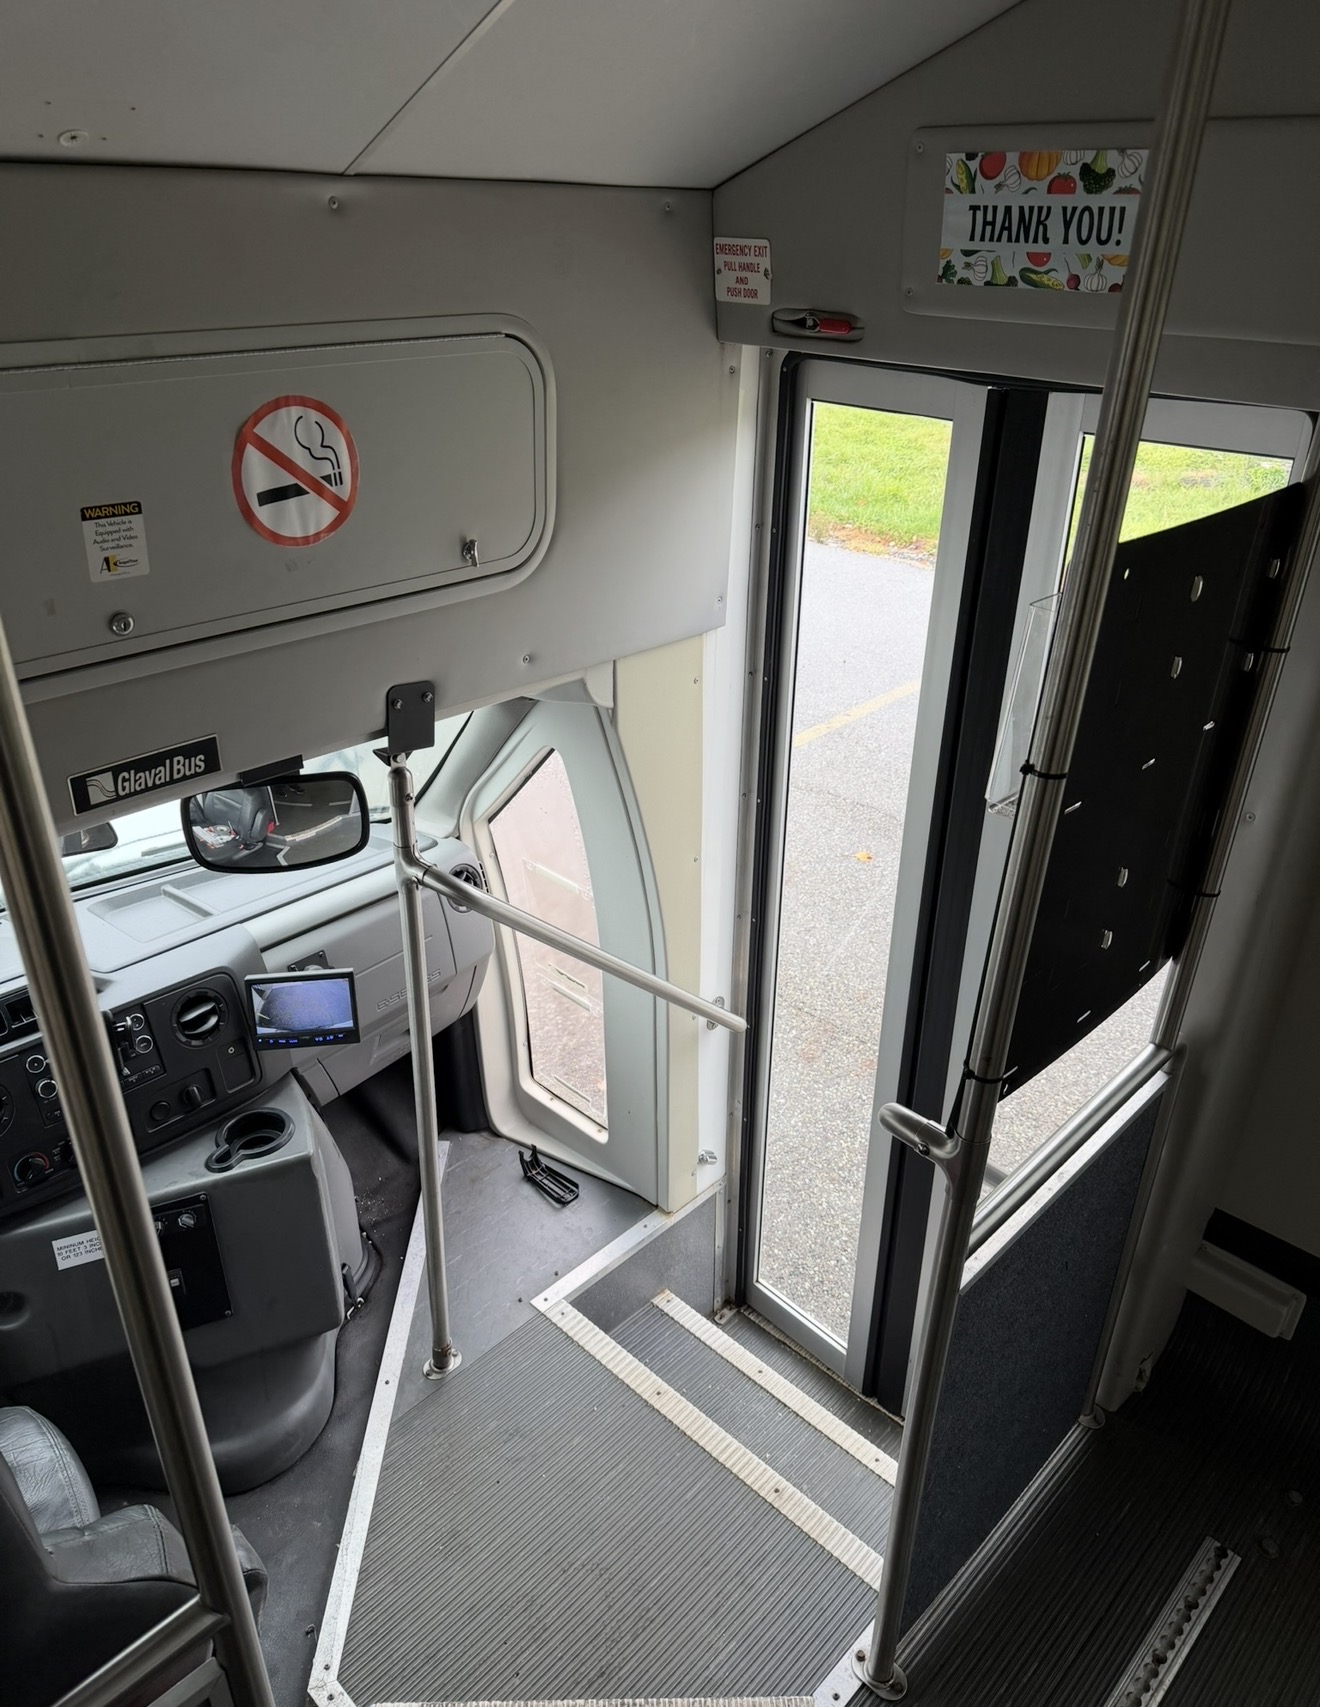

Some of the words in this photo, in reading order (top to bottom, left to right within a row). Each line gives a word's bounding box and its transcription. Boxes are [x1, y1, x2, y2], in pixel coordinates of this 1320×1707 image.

[968, 205, 1052, 245] THANK
[1061, 205, 1127, 247] YOU!
[715, 243, 752, 257] EMERGENCY
[753, 245, 768, 258] EXIT
[723, 260, 737, 272] PULL
[738, 261, 761, 274] HANDLE
[735, 276, 749, 286] AND
[726, 286, 742, 298] PUSH
[742, 287, 759, 300] DOOR
[83, 503, 139, 519] WARNING
[106, 519, 127, 527] Vehicle
[94, 527, 121, 538] Equipped
[122, 525, 135, 533] with
[117, 758, 171, 797] Glaval
[172, 753, 206, 780] Bus
[84, 1246, 103, 1254] INCHE
